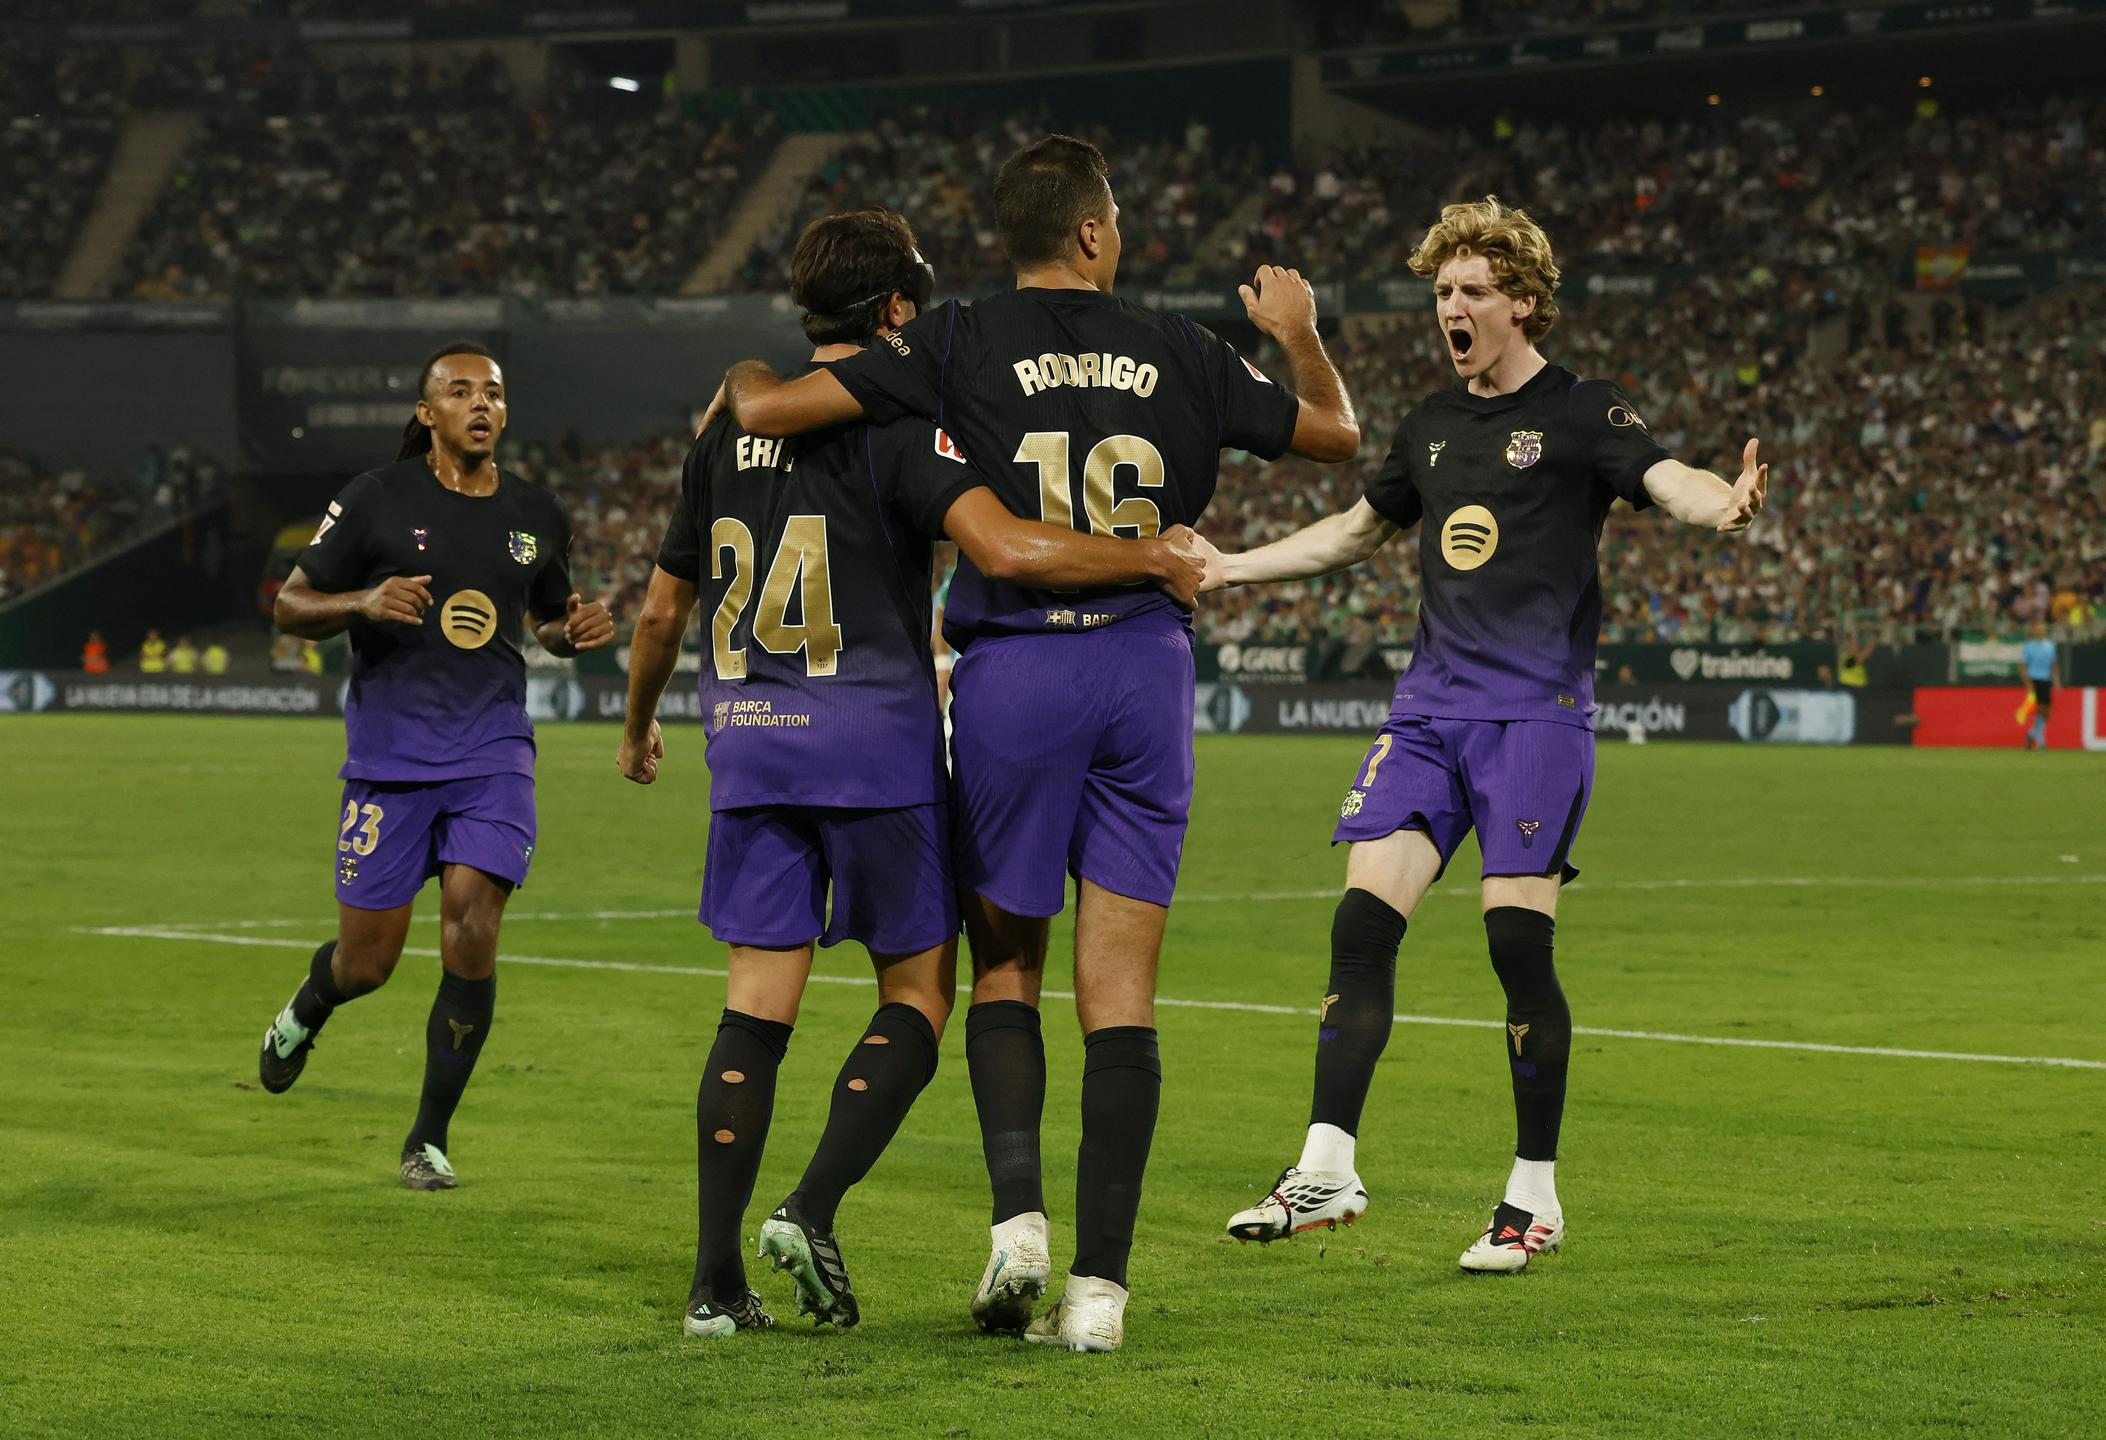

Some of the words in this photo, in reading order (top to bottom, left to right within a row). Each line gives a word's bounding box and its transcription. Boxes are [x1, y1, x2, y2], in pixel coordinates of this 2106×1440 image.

[1013, 352, 1159, 398] RODRIGO
[736, 434, 794, 473] ERI
[1013, 431, 1165, 540] 16
[711, 515, 843, 680] 24
[730, 714, 810, 727] FOUNDATION
[733, 701, 771, 717] BARÇA
[1279, 700, 1309, 727] LA
[1362, 734, 1392, 787] 7
[338, 799, 384, 856] 23
